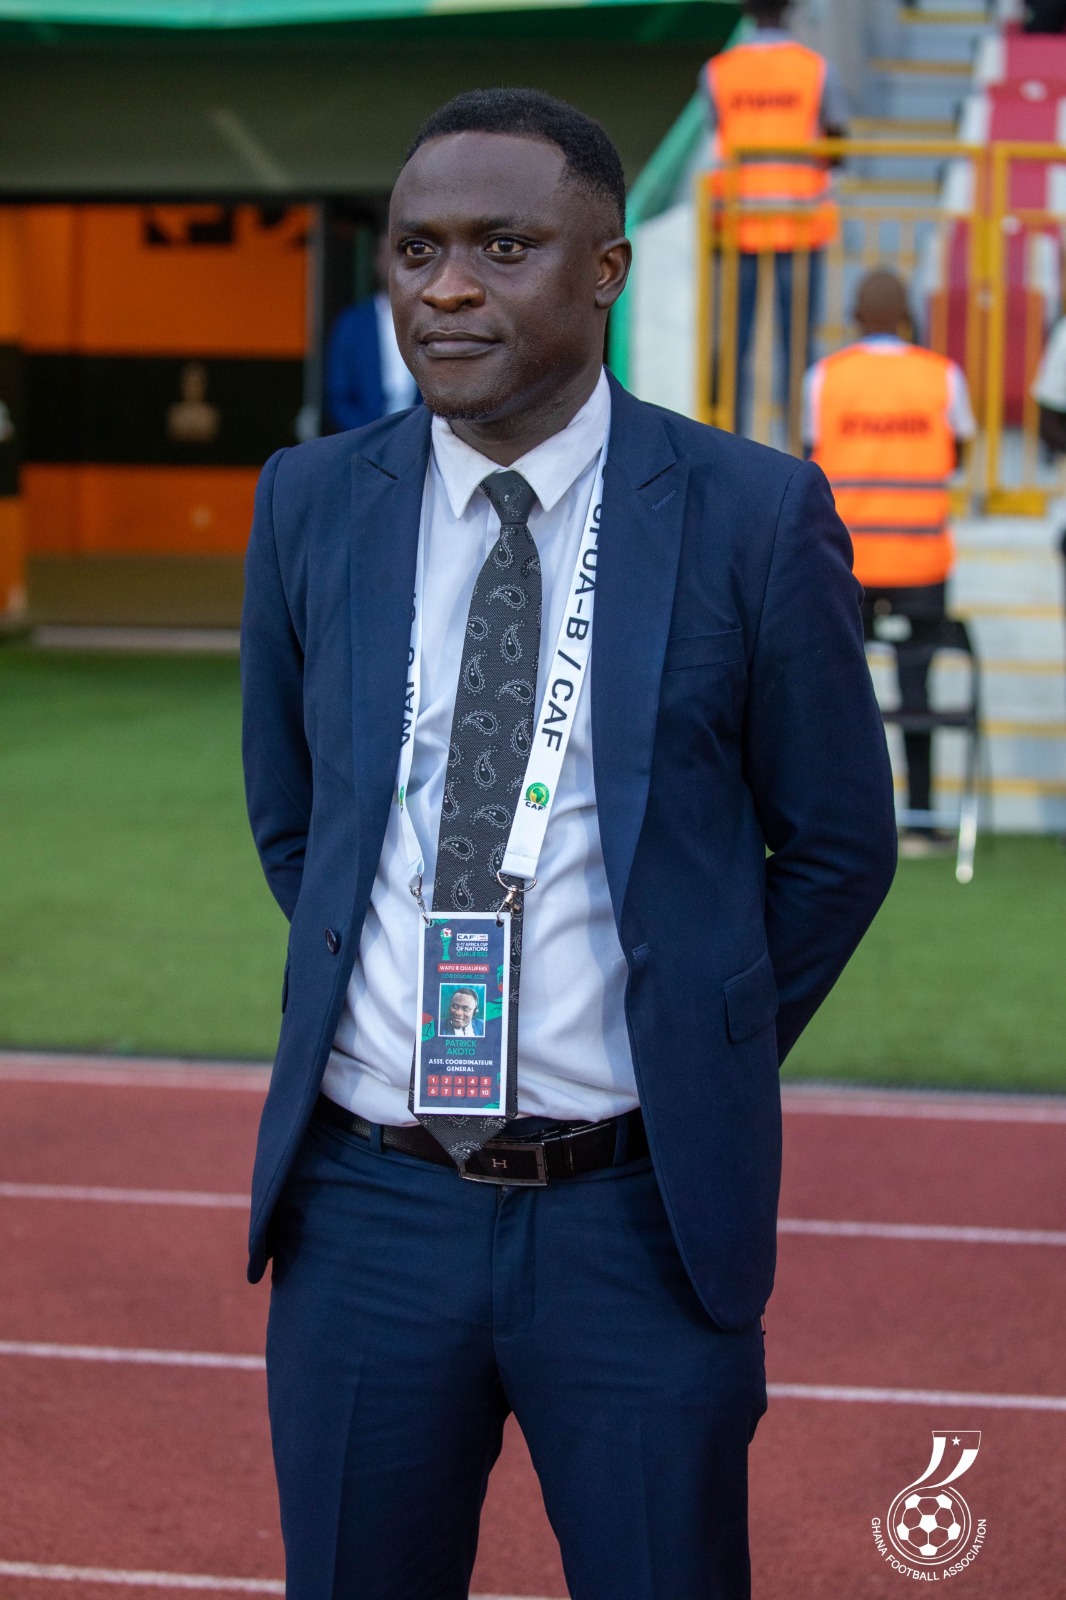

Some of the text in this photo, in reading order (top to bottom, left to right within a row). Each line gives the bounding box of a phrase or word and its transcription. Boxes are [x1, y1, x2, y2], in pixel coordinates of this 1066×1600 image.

[541, 678, 574, 752] CAF
[525, 801, 544, 811] CAF
[445, 1039, 477, 1047] PATRICK
[446, 1047, 476, 1056] AKOTO
[491, 1158, 508, 1169] H
